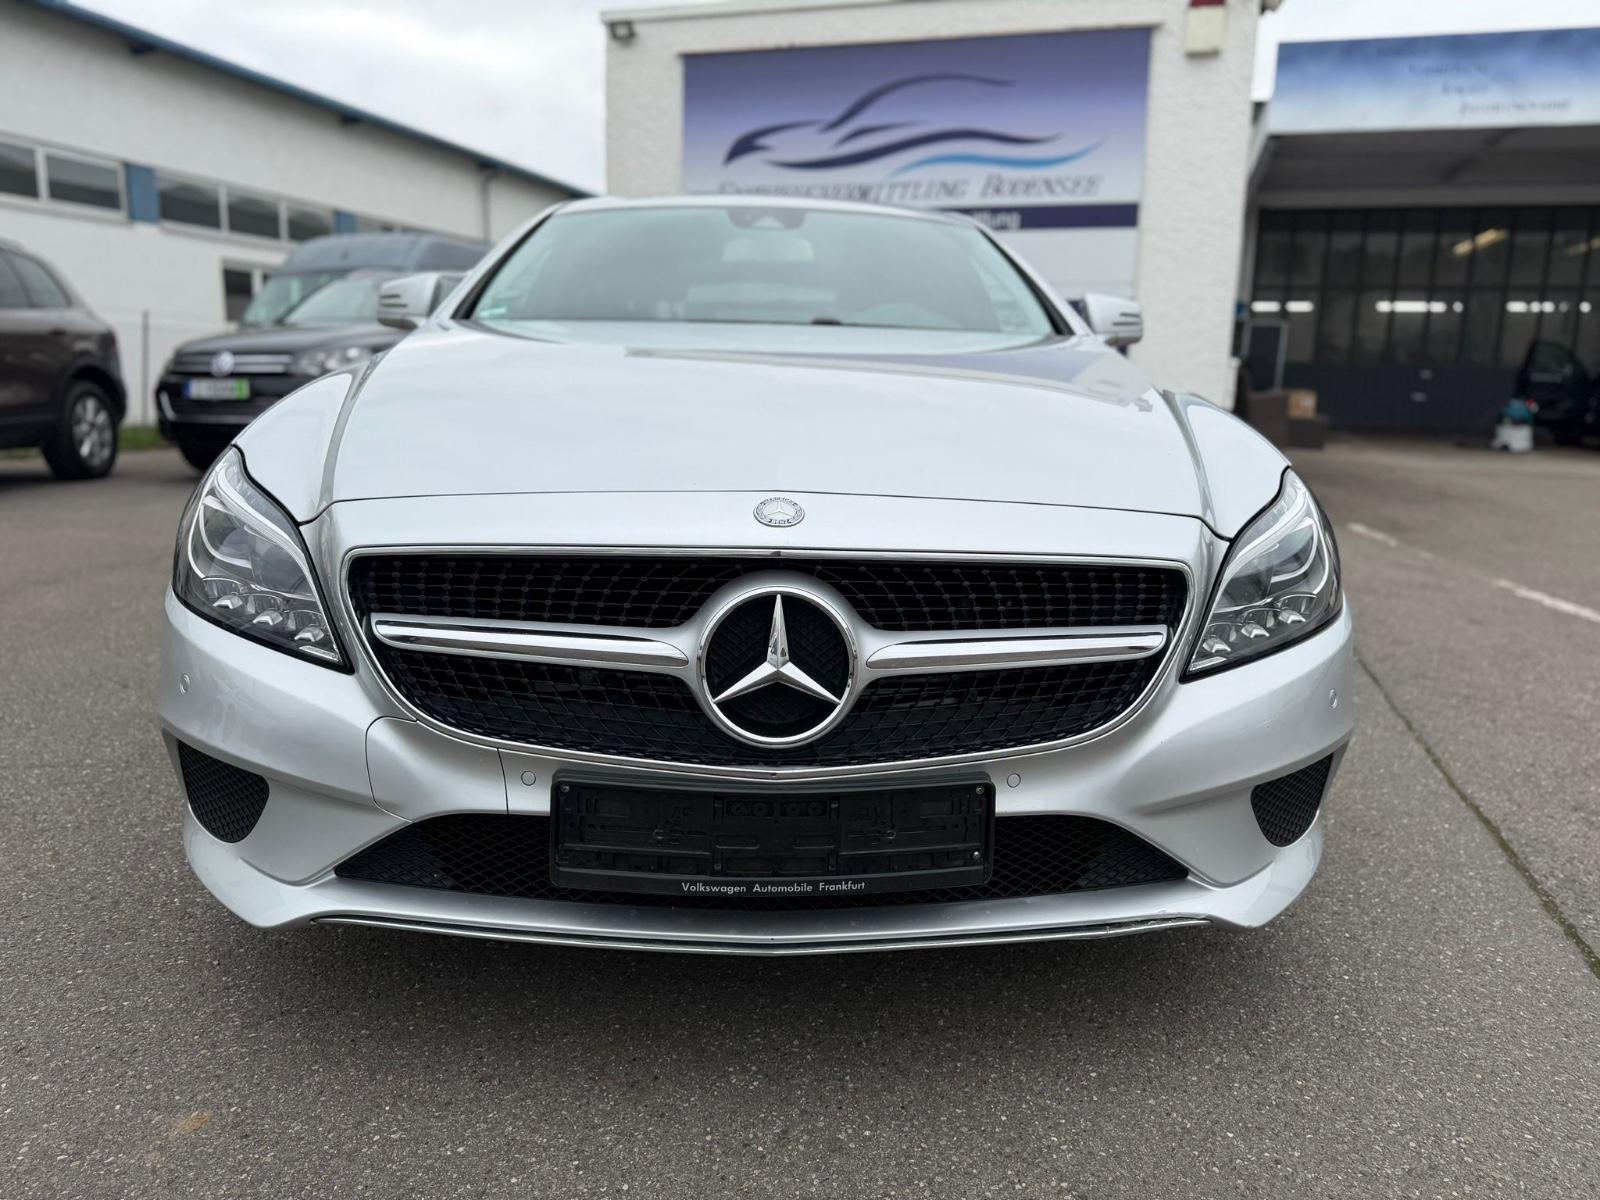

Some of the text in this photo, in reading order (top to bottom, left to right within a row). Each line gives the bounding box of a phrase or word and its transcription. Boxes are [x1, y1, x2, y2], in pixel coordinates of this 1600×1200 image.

[681, 880, 866, 895] Volkswagen Automobile Frankfurt
